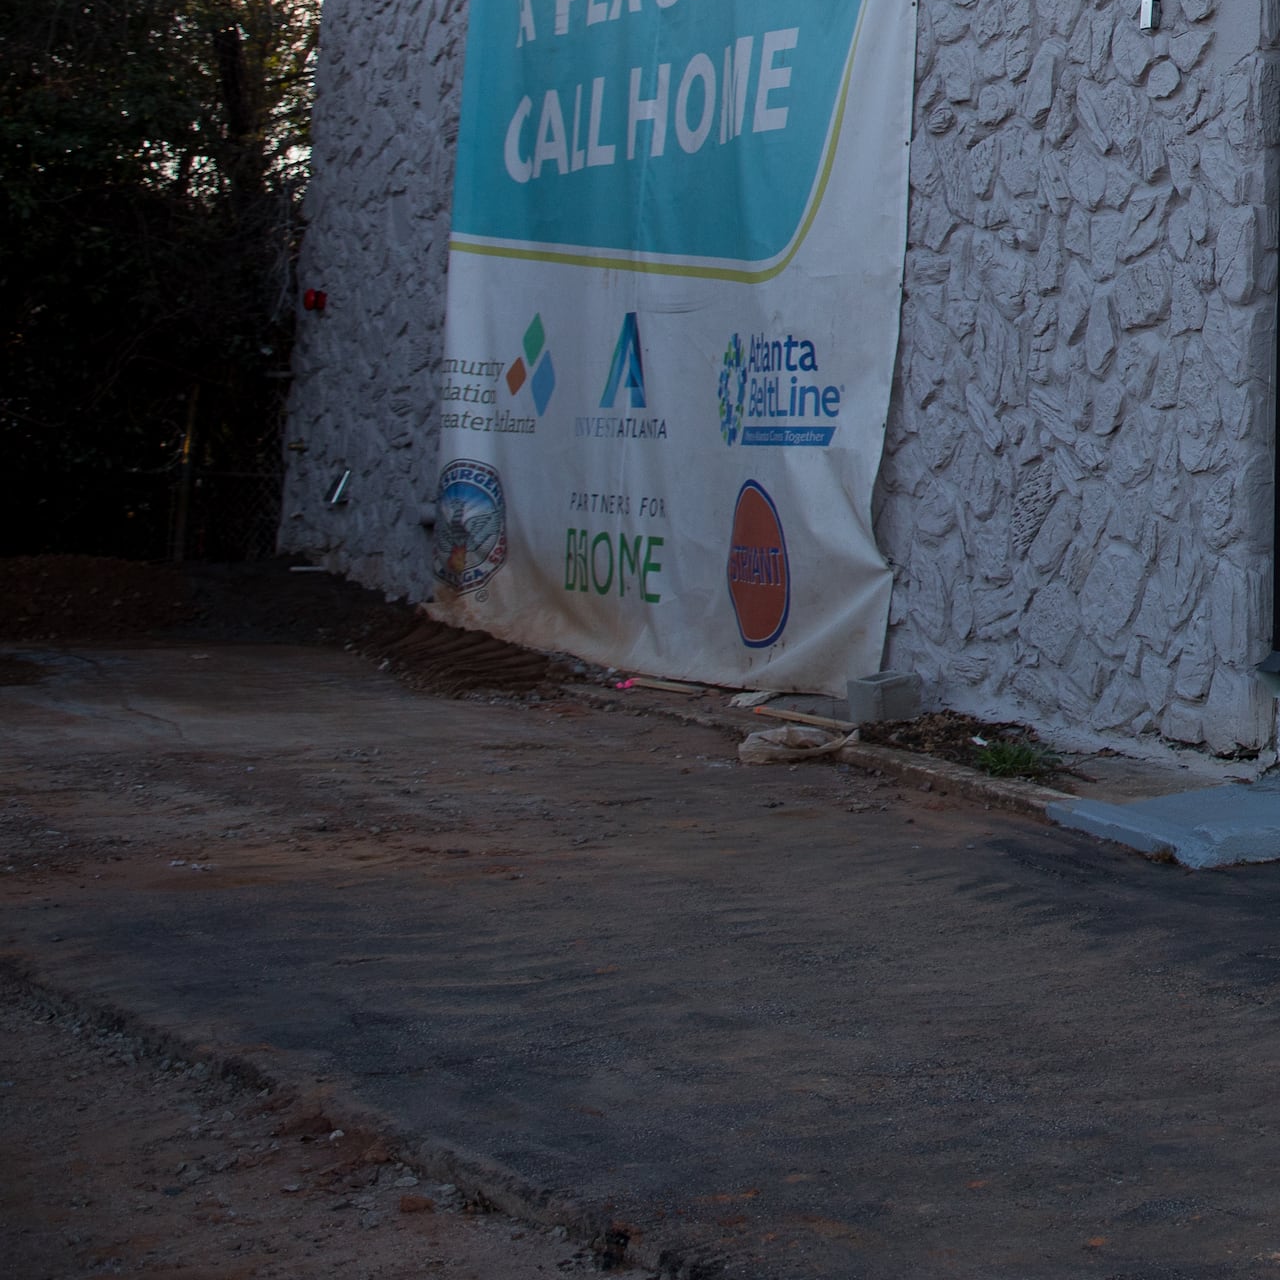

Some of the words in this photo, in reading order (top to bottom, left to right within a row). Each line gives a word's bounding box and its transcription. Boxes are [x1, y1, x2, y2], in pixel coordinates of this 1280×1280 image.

[503, 77, 616, 184] CALL
[626, 27, 799, 161] HOME
[748, 332, 818, 372] Atlanta
[748, 376, 840, 418] BeltLine
[570, 492, 631, 516] PARTNERS
[639, 497, 666, 518] FOR
